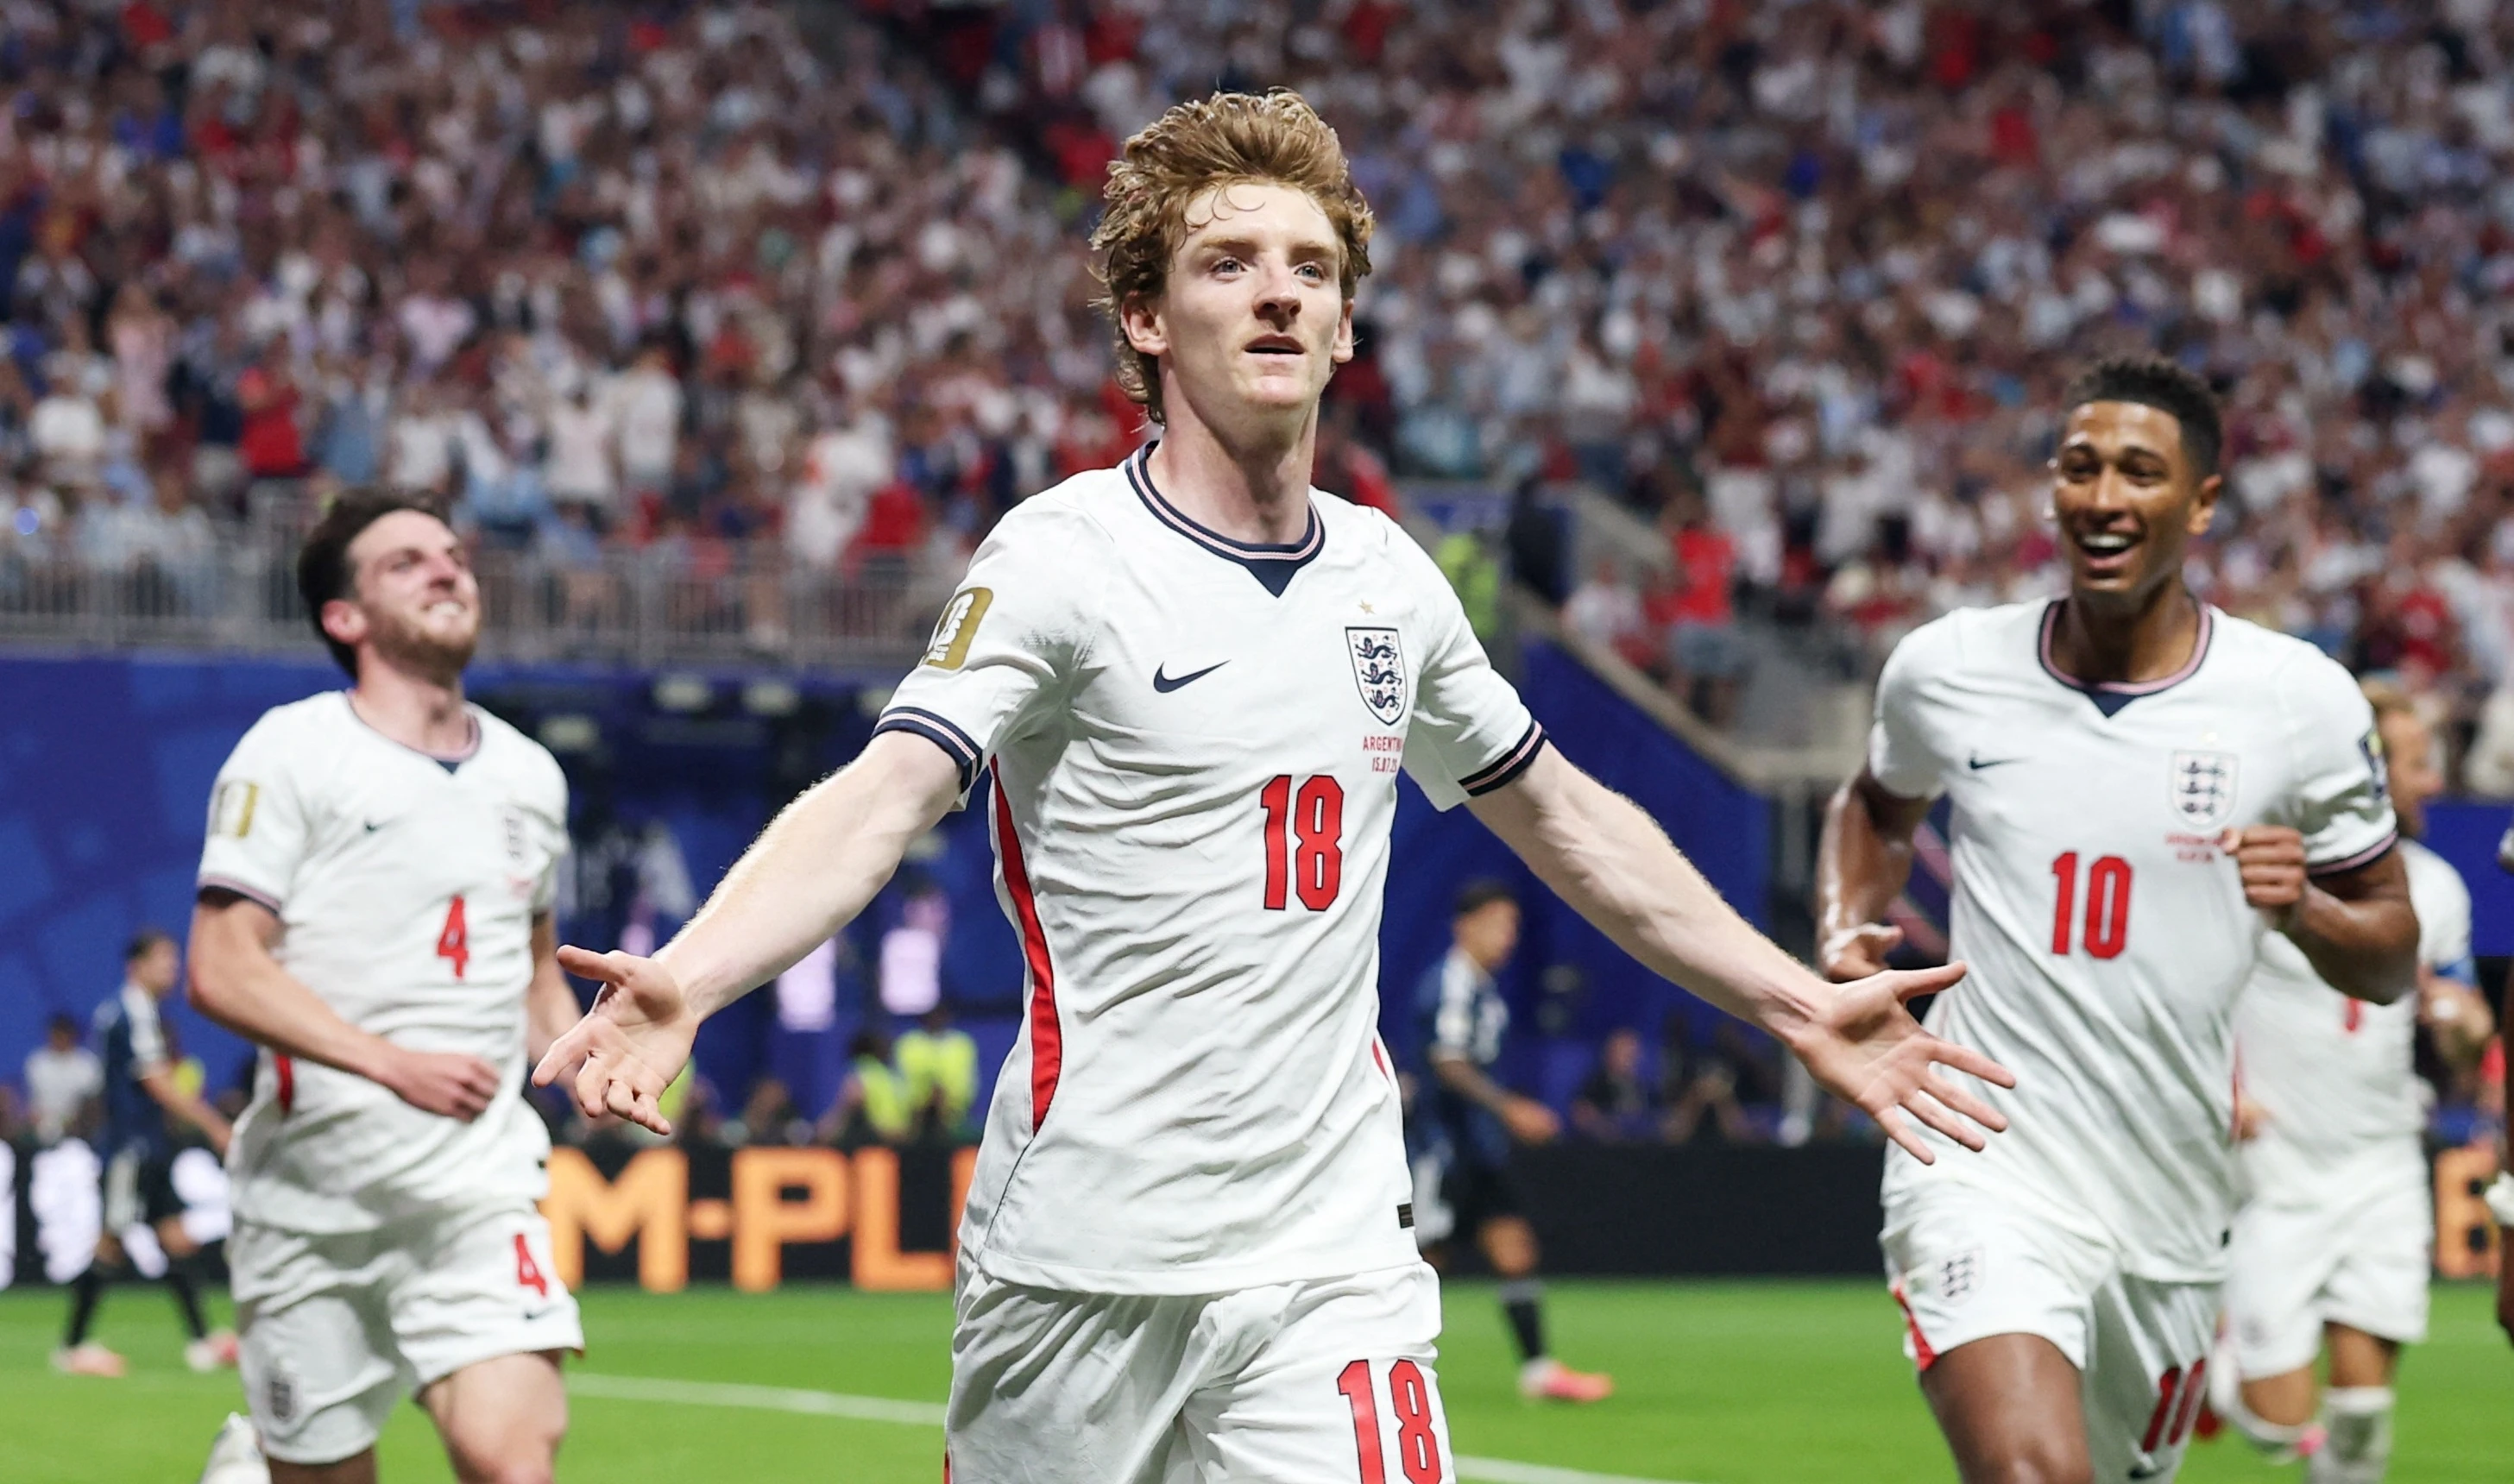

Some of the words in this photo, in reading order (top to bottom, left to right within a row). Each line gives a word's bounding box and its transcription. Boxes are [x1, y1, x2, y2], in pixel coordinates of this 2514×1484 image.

[1260, 774, 1344, 912] 18
[438, 894, 469, 978] 4
[2051, 851, 2133, 959] 10
[514, 1233, 546, 1298] 4
[1337, 1359, 1442, 1484] 18
